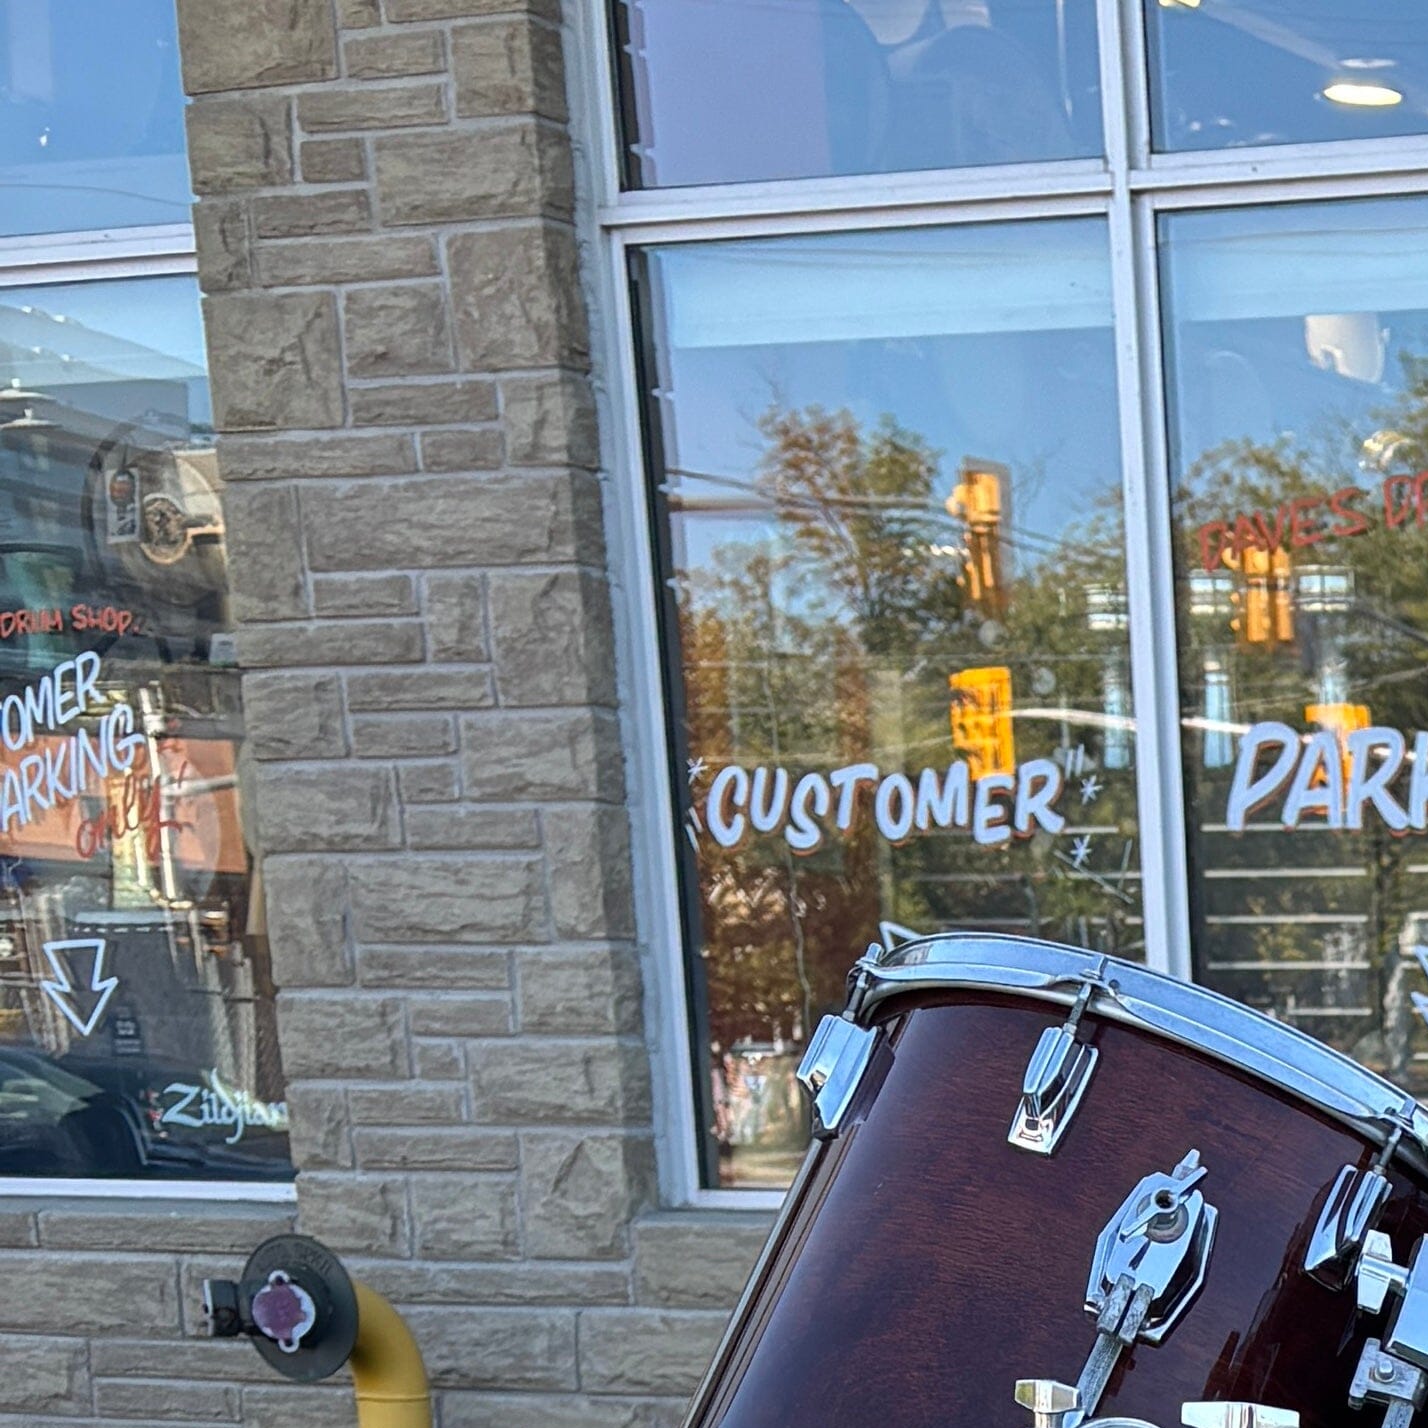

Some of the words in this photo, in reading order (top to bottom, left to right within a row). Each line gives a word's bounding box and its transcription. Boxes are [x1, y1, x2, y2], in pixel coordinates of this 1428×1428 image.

[0, 609, 63, 639] DRUM
[0, 650, 107, 751] OMER
[162, 1067, 289, 1144] Zildjian
